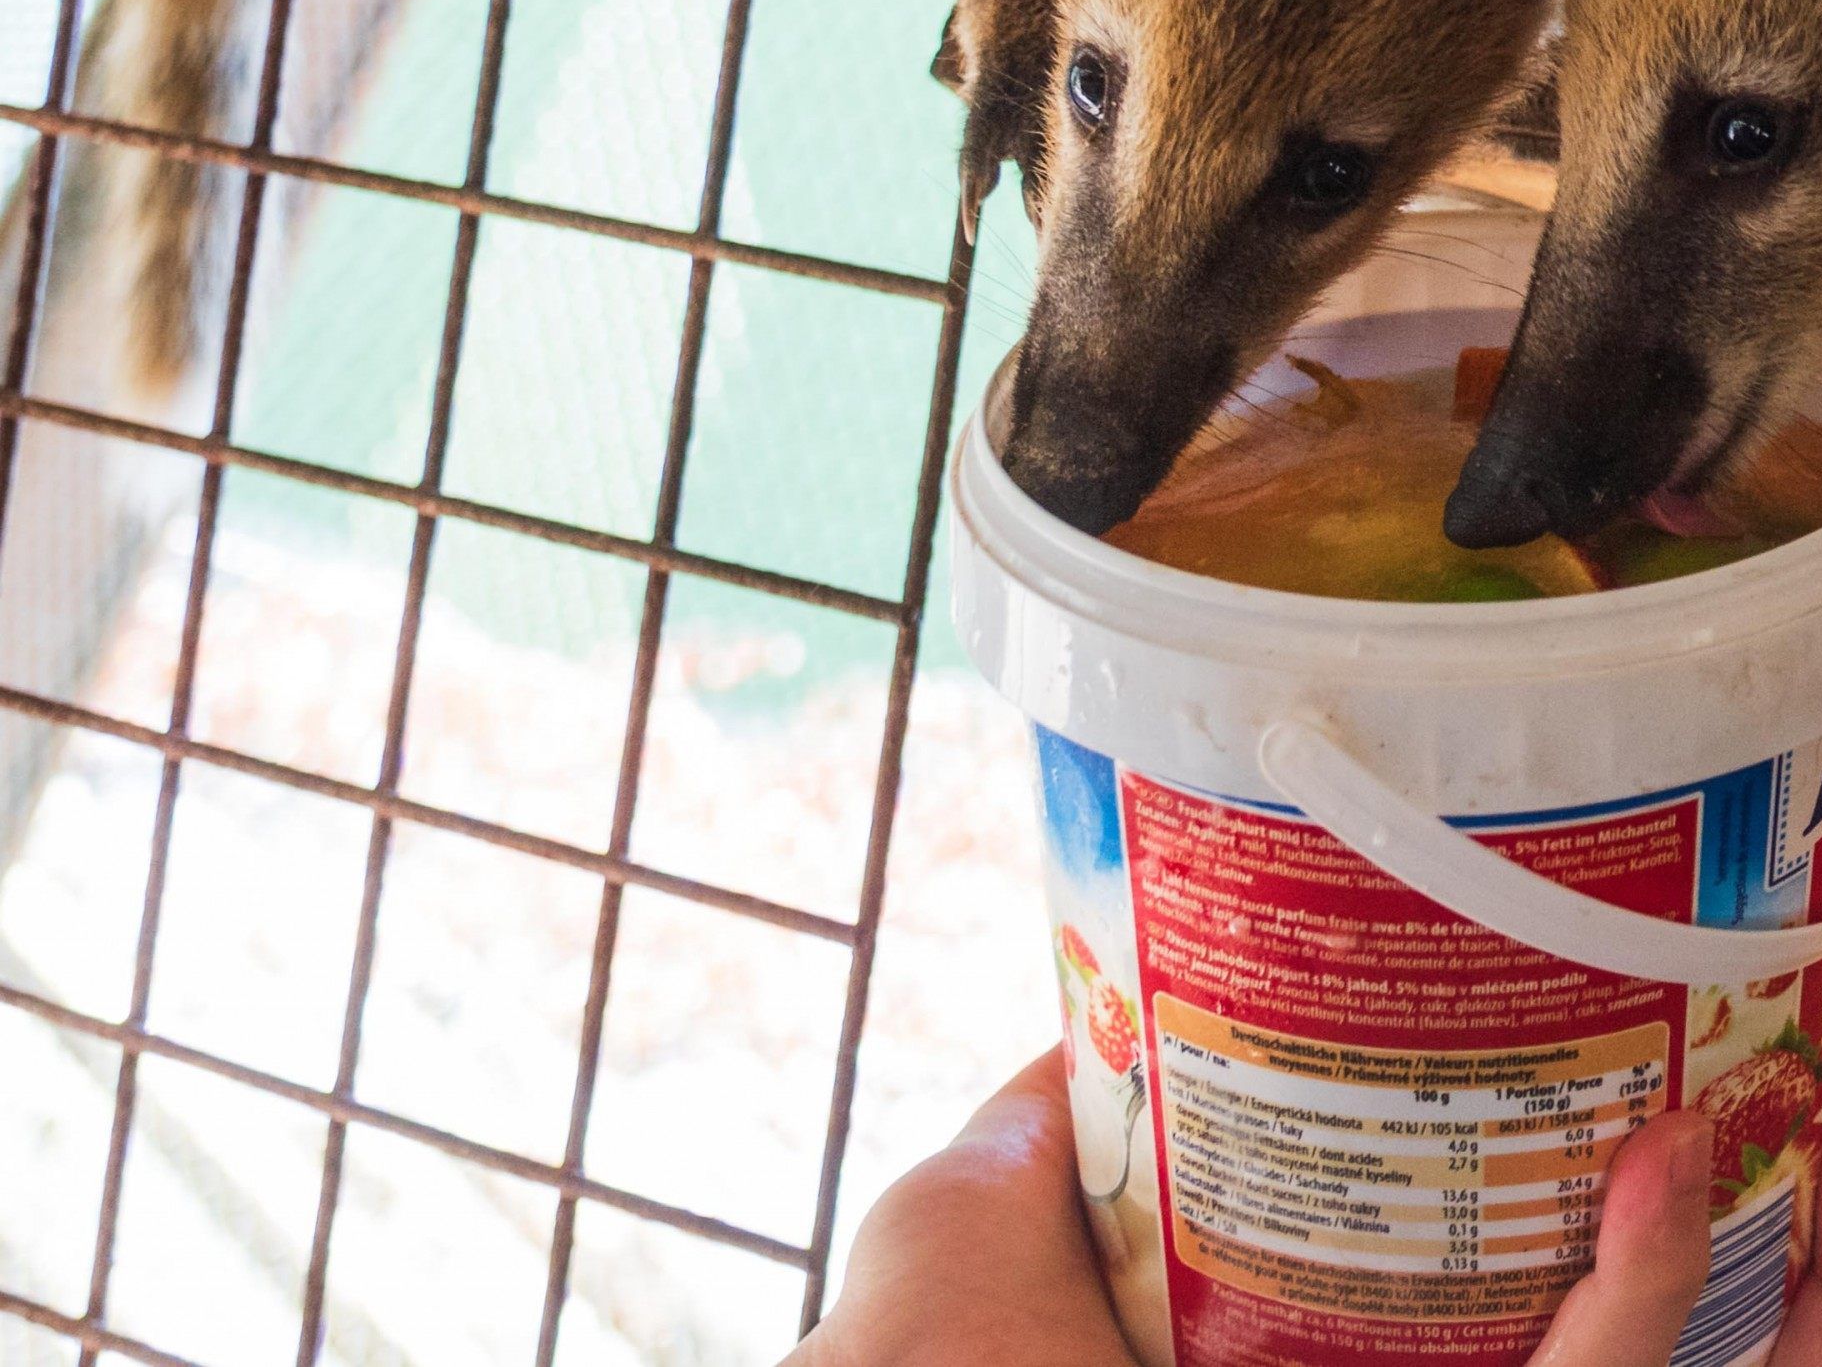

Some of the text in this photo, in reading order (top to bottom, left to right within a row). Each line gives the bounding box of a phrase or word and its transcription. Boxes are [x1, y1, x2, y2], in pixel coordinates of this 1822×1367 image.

[1269, 826, 1300, 847] mild
[1515, 839, 1539, 854] 5%
[1541, 835, 1573, 852] Fett
[1575, 832, 1594, 847] im
[1598, 813, 1678, 843] Milchanteil
[1212, 863, 1254, 884] Sahne
[1242, 896, 1276, 916] sucré
[1277, 907, 1328, 929] parfum
[1329, 913, 1369, 934] fraise
[1371, 920, 1402, 934] avec
[1404, 921, 1429, 936] 8%
[1430, 921, 1449, 936] de
[1365, 936, 1438, 956] préparation
[1440, 939, 1457, 952] de
[1460, 938, 1501, 952] fraises
[1385, 949, 1449, 969] concentré
[1450, 956, 1465, 969] de
[1467, 954, 1512, 969] carotte
[1208, 944, 1265, 977] jahodový
[1267, 959, 1311, 983] jogurt
[1312, 974, 1320, 986] s
[1321, 972, 1345, 989] 8%
[1347, 976, 1393, 996] jahod,
[1396, 980, 1419, 996] 5%
[1421, 980, 1457, 996] tuku
[1470, 976, 1539, 996] mléčném
[1541, 971, 1589, 993] podílu
[1292, 999, 1346, 1025] rostlinný
[1347, 1008, 1416, 1030] koncentrát
[1606, 988, 1665, 1013] smetana
[1363, 993, 1416, 1015] (jahody,
[1421, 1000, 1451, 1014] cukr,
[1180, 1039, 1205, 1061] pour
[1230, 1026, 1581, 1071] Durchschnittliche Nährwerte Valeurs nutritionnelles
[1269, 1054, 1537, 1087] moyennes Průměrné výživové hodnoty:
[1495, 1076, 1603, 1101] 1 Portion Porce
[1619, 1074, 1662, 1098] (150 g)
[1413, 1089, 1450, 1106] 100 g
[1524, 1095, 1571, 1115] (150 g)
[1628, 1097, 1648, 1112] 8%
[1279, 1119, 1303, 1141] Tuky
[1315, 1109, 1363, 1131] hodnota
[1380, 1121, 1479, 1135] 442 kJ 105 kcal
[1524, 1117, 1538, 1132] kJ
[1549, 1113, 1571, 1128] 158
[1571, 1109, 1595, 1126] kcal
[1565, 1127, 1594, 1143] 6,0 g
[1318, 1146, 1346, 1164] dont
[1347, 1152, 1384, 1168] acides
[1448, 1139, 1479, 1155] 4,0 g
[1564, 1143, 1594, 1160] 4,1 g
[1271, 1149, 1413, 1187] nasycené mastné kyseliny
[1448, 1157, 1479, 1173] 2,7 g
[1295, 1174, 1350, 1198] Sacharidy
[1557, 1176, 1593, 1193] 20,4 g
[1441, 1189, 1479, 1205] 13,6 g
[1584, 1194, 1593, 1209] g
[1320, 1196, 1347, 1213] toho
[1349, 1202, 1381, 1219] cukry
[1442, 1207, 1479, 1223] 13,0 g
[1267, 1201, 1391, 1236] alimentaires Vláknina
[1562, 1211, 1592, 1226] 0,2 g
[1448, 1224, 1479, 1240] 0,1 g
[1449, 1240, 1479, 1257] 3,5 g
[1555, 1247, 1582, 1263] 0,20
[1441, 1258, 1479, 1274] 0,13 g
[1410, 1271, 1488, 1289] Erwachsenen
[1489, 1270, 1523, 1286] (8400
[1360, 1284, 1393, 1301] (8400
[1421, 1302, 1455, 1318] (8400
[1457, 1299, 1505, 1317] kJ/2000
[1335, 1317, 1402, 1339] Portionen
[1416, 1324, 1441, 1339] 150
[1441, 1326, 1451, 1342] g
[1462, 1323, 1486, 1338] Cet
[1311, 1330, 1328, 1345] de
[1330, 1333, 1353, 1348] 150
[1355, 1337, 1365, 1351] g
[1373, 1336, 1417, 1355] Balení
[1419, 1338, 1481, 1357] obsahuje
[1482, 1338, 1504, 1353] cca
[1506, 1337, 1516, 1351] 6
